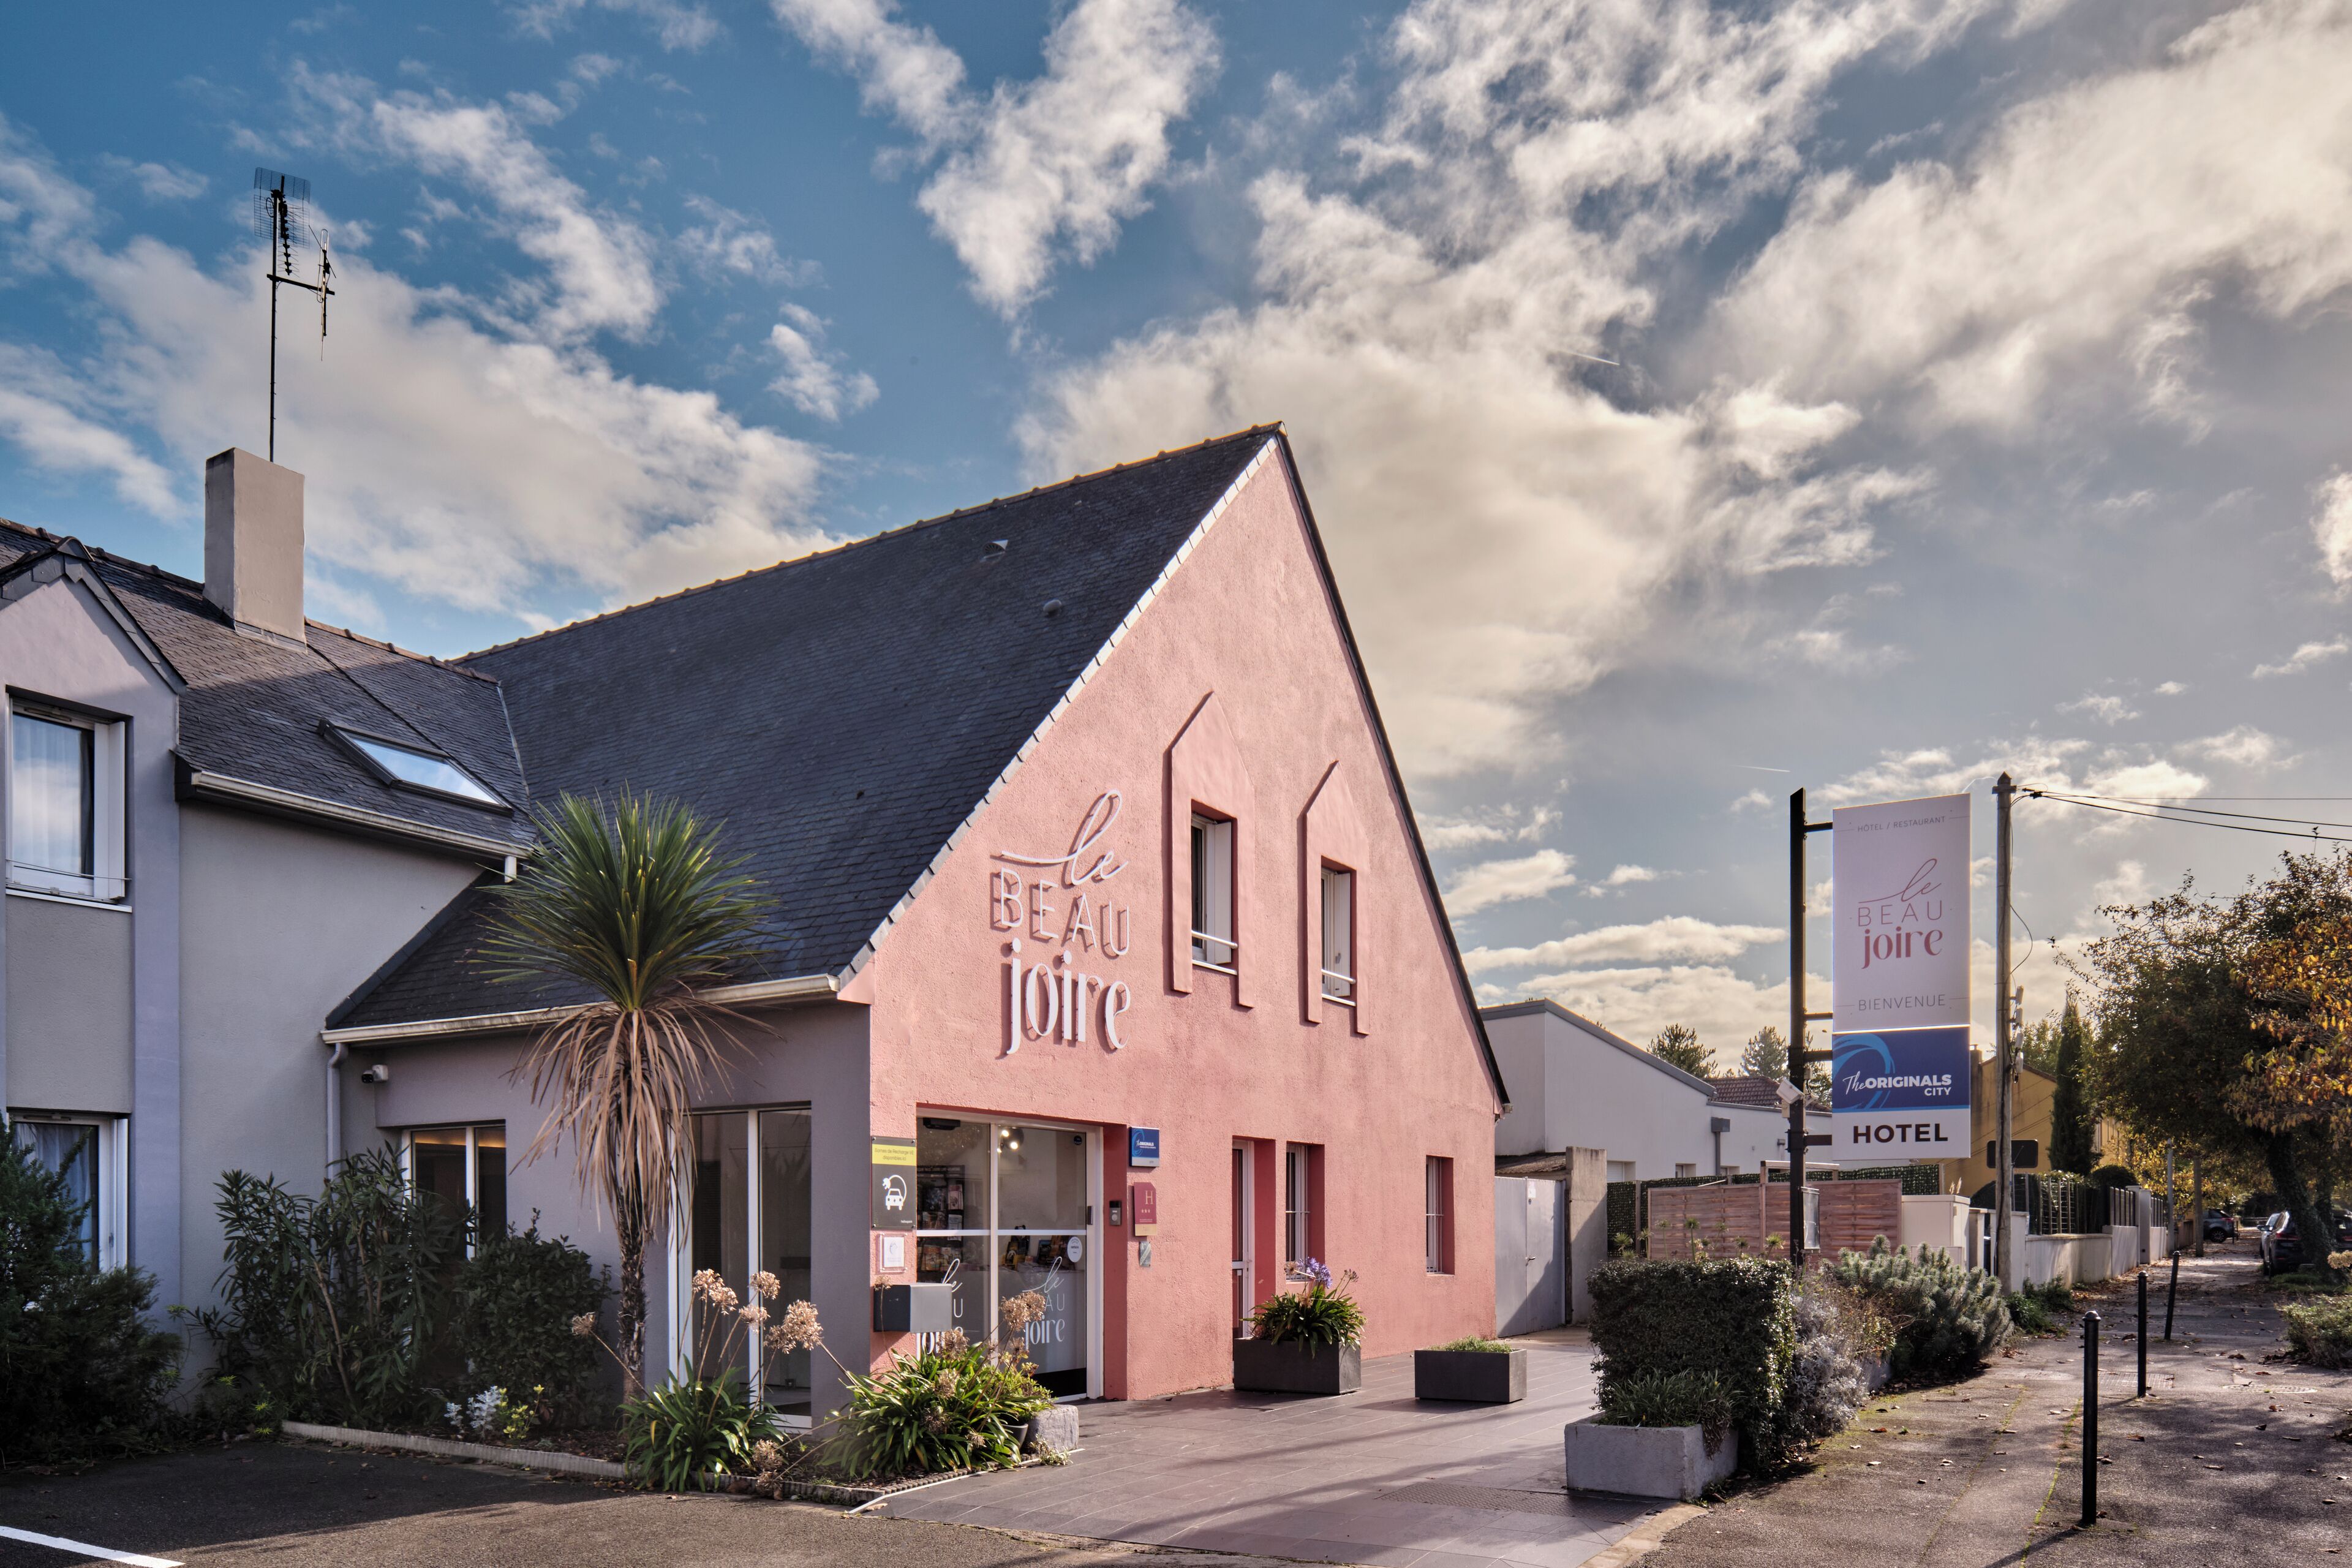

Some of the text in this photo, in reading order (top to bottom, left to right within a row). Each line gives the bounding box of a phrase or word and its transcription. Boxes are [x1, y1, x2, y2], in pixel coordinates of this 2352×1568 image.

[1001, 790, 1129, 885] le
[1858, 823, 1883, 832] HÔTEL
[1893, 816, 1946, 828] RESTAURANT
[1858, 858, 1942, 902] le
[1001, 867, 1130, 956] BEAU
[1858, 900, 1942, 927] BEAU
[1861, 926, 1943, 969] joire
[1006, 937, 1131, 1055] joire
[1858, 994, 1946, 1011] BIENVENUE
[1924, 1087, 1951, 1096] CITY
[1853, 1123, 1948, 1144] HOTEL
[1145, 1190, 1153, 1205] H
